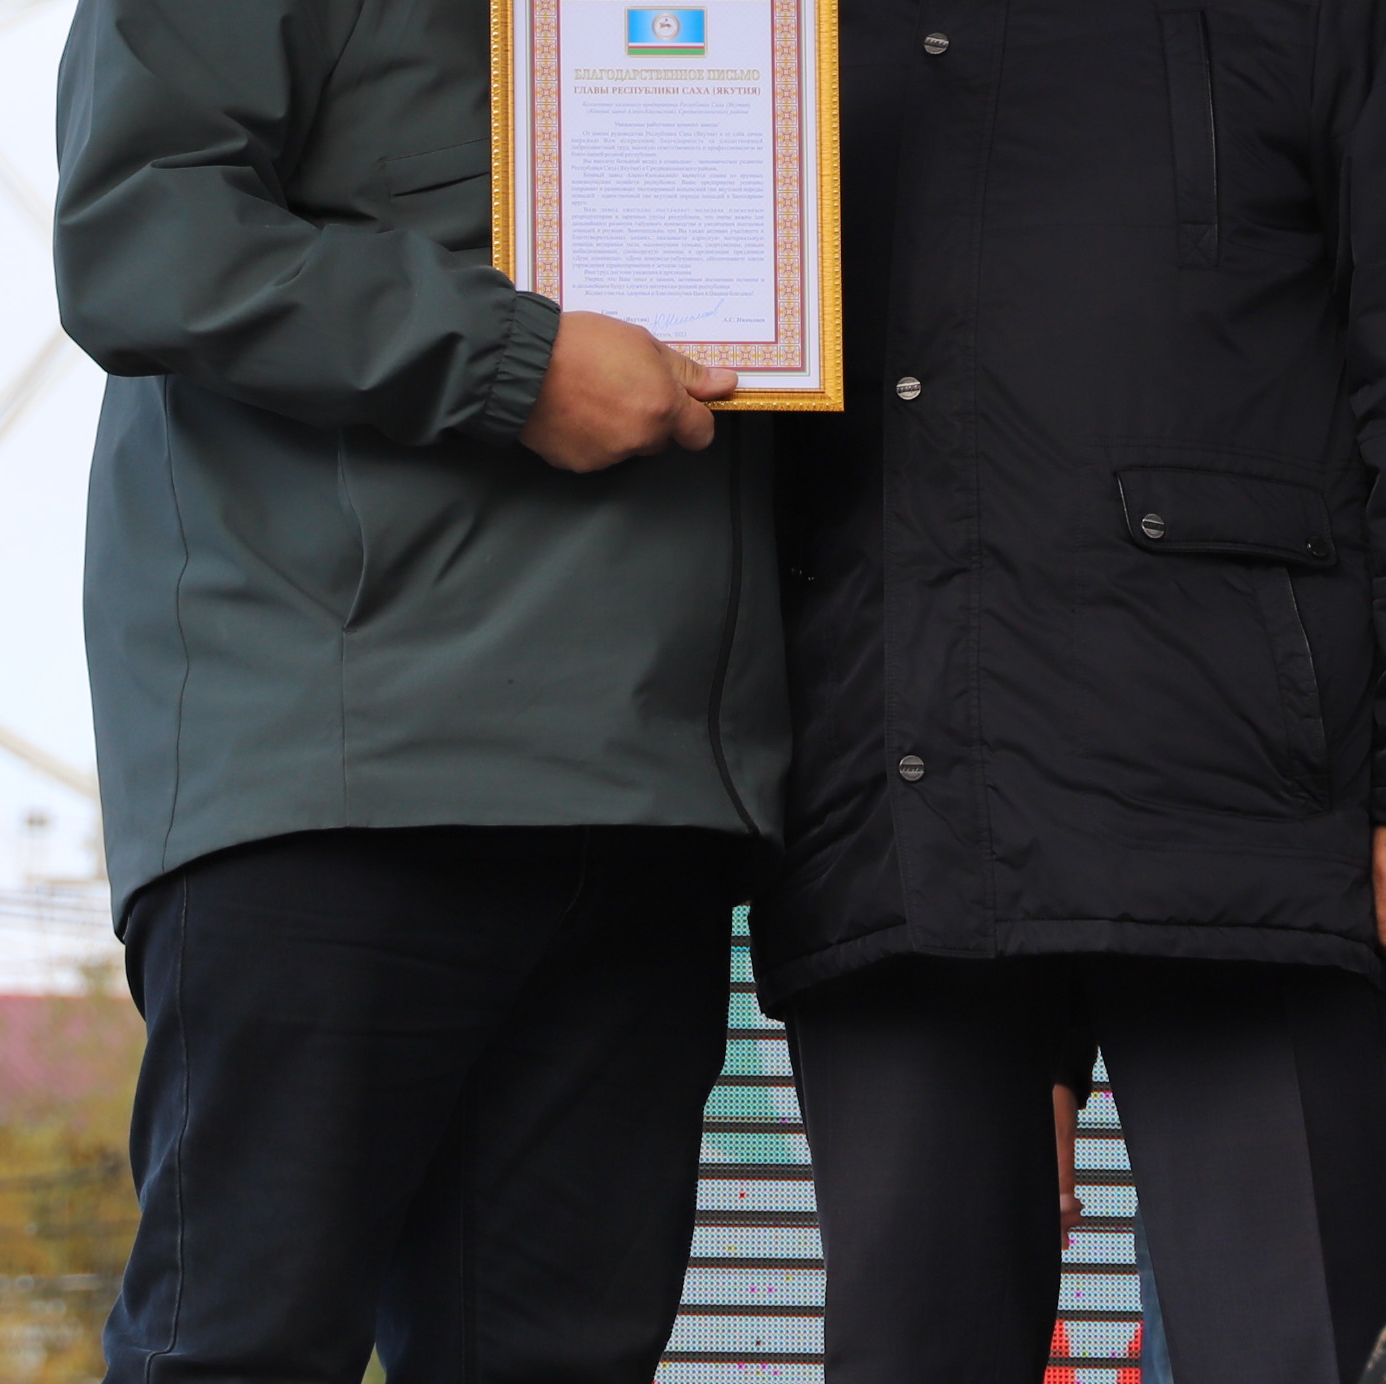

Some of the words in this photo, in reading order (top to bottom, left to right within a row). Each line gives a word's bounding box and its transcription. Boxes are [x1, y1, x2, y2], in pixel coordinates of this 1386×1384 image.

[574, 68, 704, 82] БЛАГОДАРСТВЕННОЕ
[707, 68, 761, 81] ПИСЬМО
[573, 86, 609, 94] ГЛАВЫ
[612, 86, 679, 94] РЕСПУБЛИКИ
[682, 86, 710, 94] САХА
[713, 86, 761, 96] (ЯКУТИЯ)
